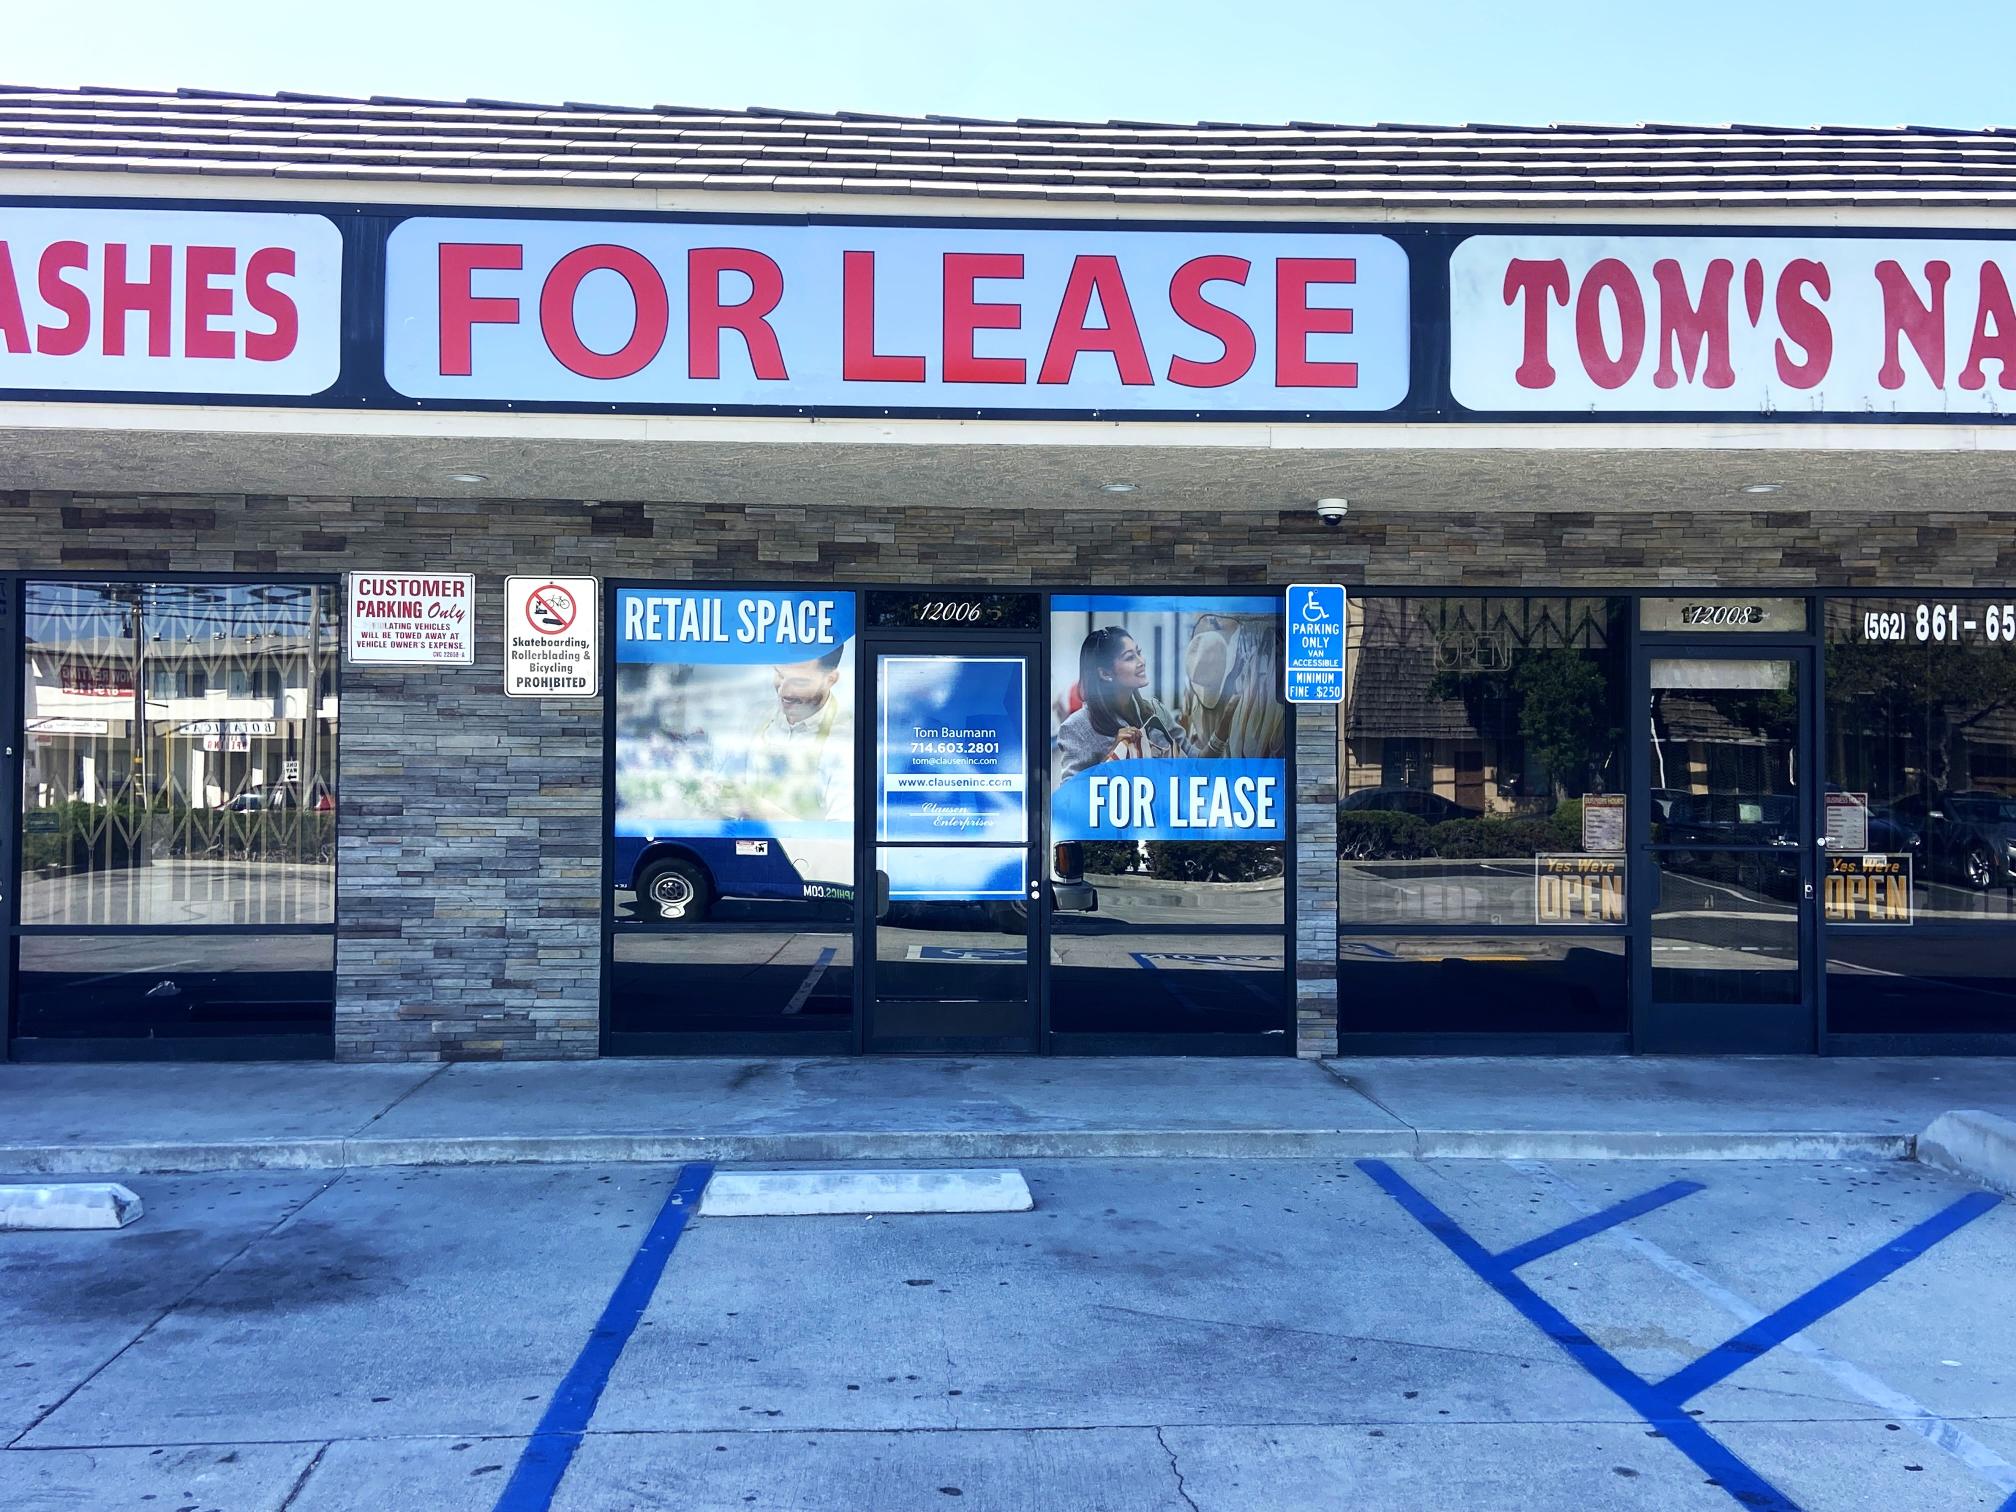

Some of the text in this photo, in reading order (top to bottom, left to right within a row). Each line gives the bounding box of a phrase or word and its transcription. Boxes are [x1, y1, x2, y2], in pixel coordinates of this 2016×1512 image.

[438, 242, 1358, 388] FOR LEASE
[1503, 258, 2016, 390] TOM'S NA
[359, 579, 465, 597] CUSTOMER
[356, 600, 466, 623] PARKING Only
[920, 602, 981, 621] 12006
[1691, 606, 1753, 625] 12008
[625, 597, 835, 644] RETAIL SPACE
[1864, 612, 1906, 640] (562)
[415, 623, 450, 631] VEHICLES
[1292, 623, 1340, 635] PARKING
[395, 632, 421, 640] TOWED
[391, 641, 425, 649] OWNER'S
[512, 637, 590, 649] Skateboarding,
[1301, 637, 1330, 648] ONLY
[511, 650, 591, 662] Rollerblading &
[1439, 635, 1508, 666] OPEN
[529, 662, 573, 674] Bicycling
[1292, 659, 1339, 667] ACCESSIBLE
[516, 677, 586, 688] PROHIBITED
[1296, 673, 1335, 684] MINIMUM
[1289, 686, 1340, 698] FINE $250
[913, 727, 996, 738] Tom Baumann
[911, 742, 999, 753] 714.603.2801
[912, 757, 997, 765] tom@clauseninc.com
[898, 777, 1012, 787] www.clauseninc.com
[922, 802, 969, 814] Clausen
[1089, 776, 1277, 828] FOR LEASE
[933, 816, 994, 831] Enterprises
[1540, 875, 1622, 919] OPEN
[1824, 875, 1907, 920] OPEN
